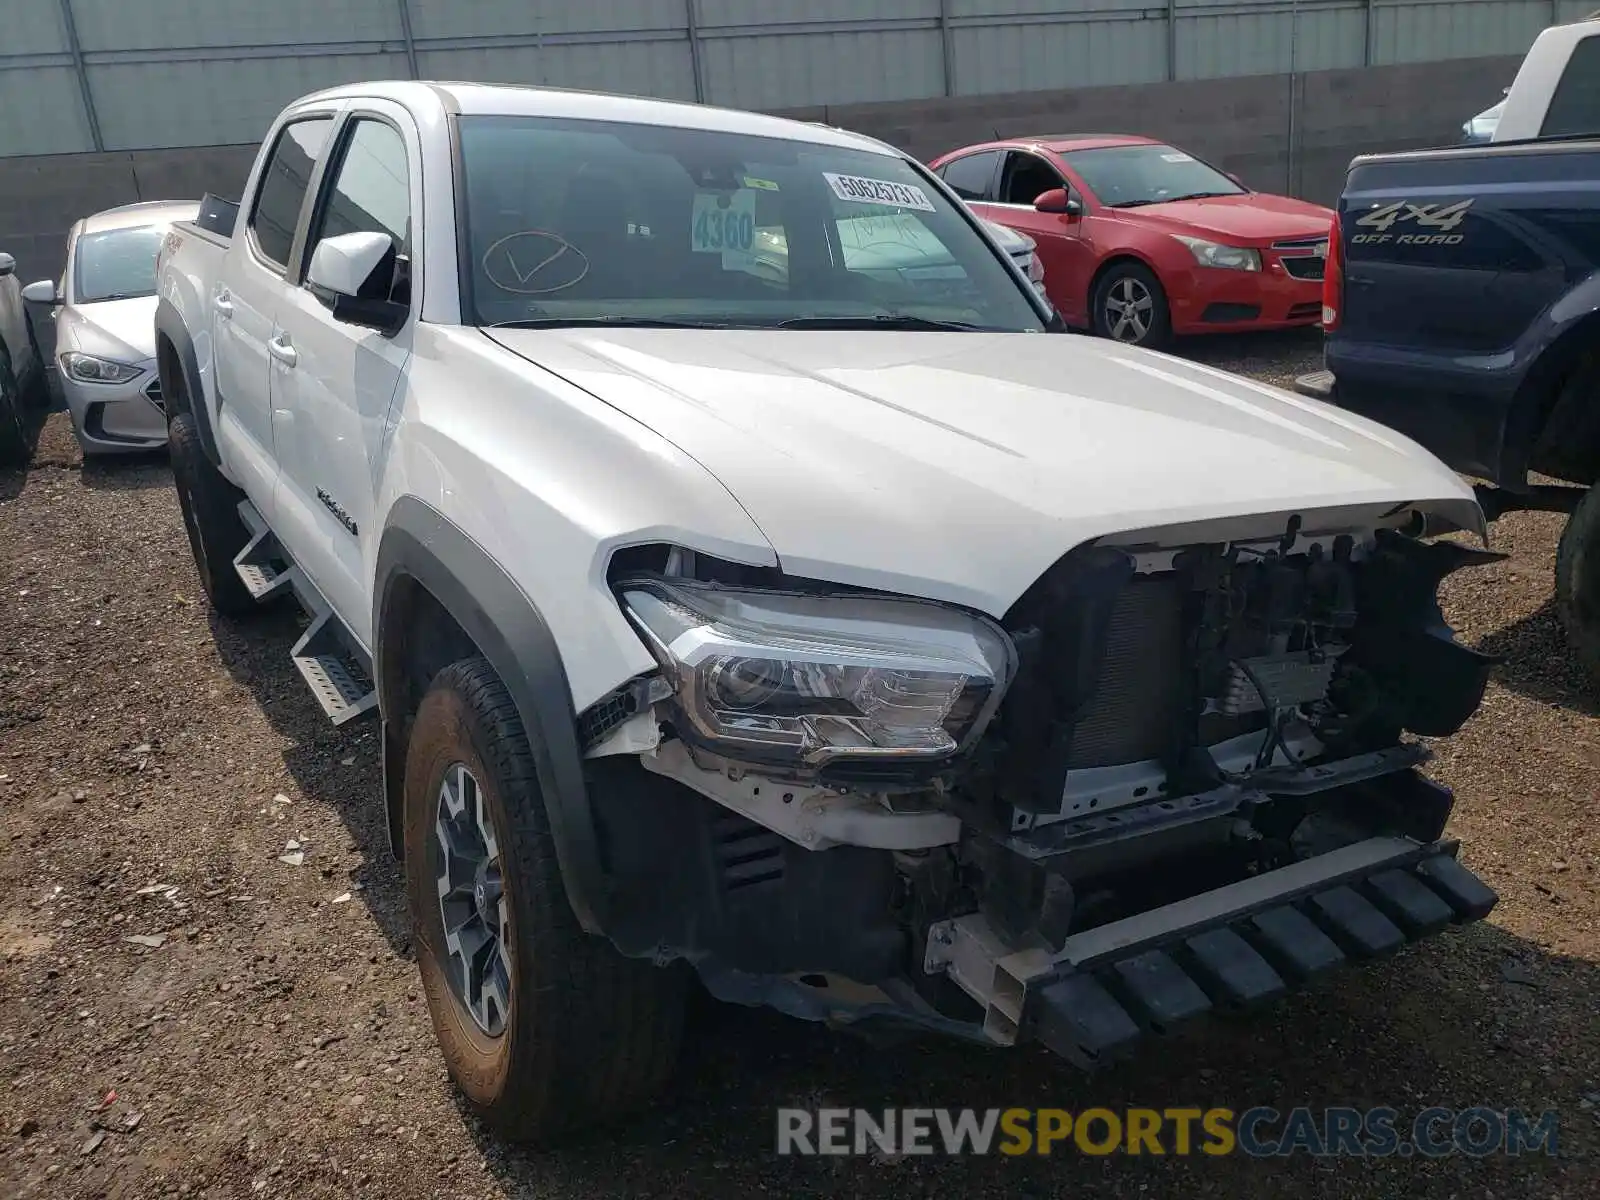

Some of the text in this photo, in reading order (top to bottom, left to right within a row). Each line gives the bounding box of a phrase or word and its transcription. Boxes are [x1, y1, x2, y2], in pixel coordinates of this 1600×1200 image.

[838, 176, 920, 205] 50625731
[694, 209, 753, 250] 4360
[1351, 234, 1464, 245] OFF ROAD
